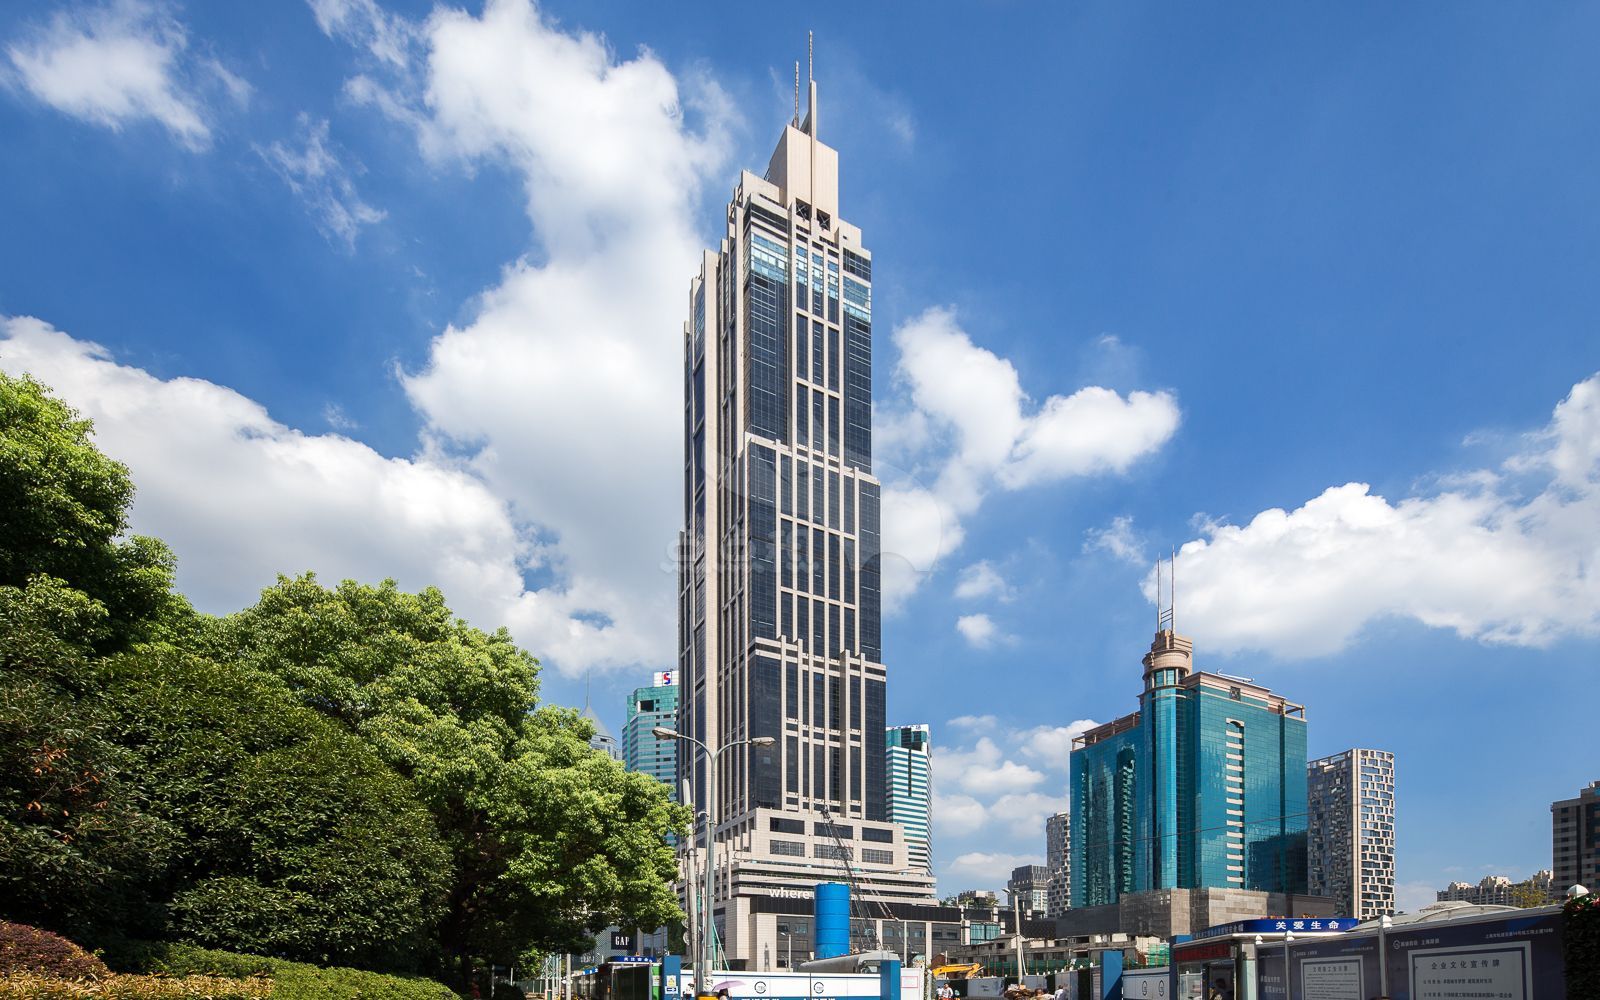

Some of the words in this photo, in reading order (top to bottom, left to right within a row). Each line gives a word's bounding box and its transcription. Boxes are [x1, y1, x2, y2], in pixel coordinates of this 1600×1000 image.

[769, 887, 810, 899] where
[1275, 921, 1340, 930] 关爱生命
[615, 936, 630, 946] GAP
[1431, 959, 1500, 970] 企业文化宣传牌
